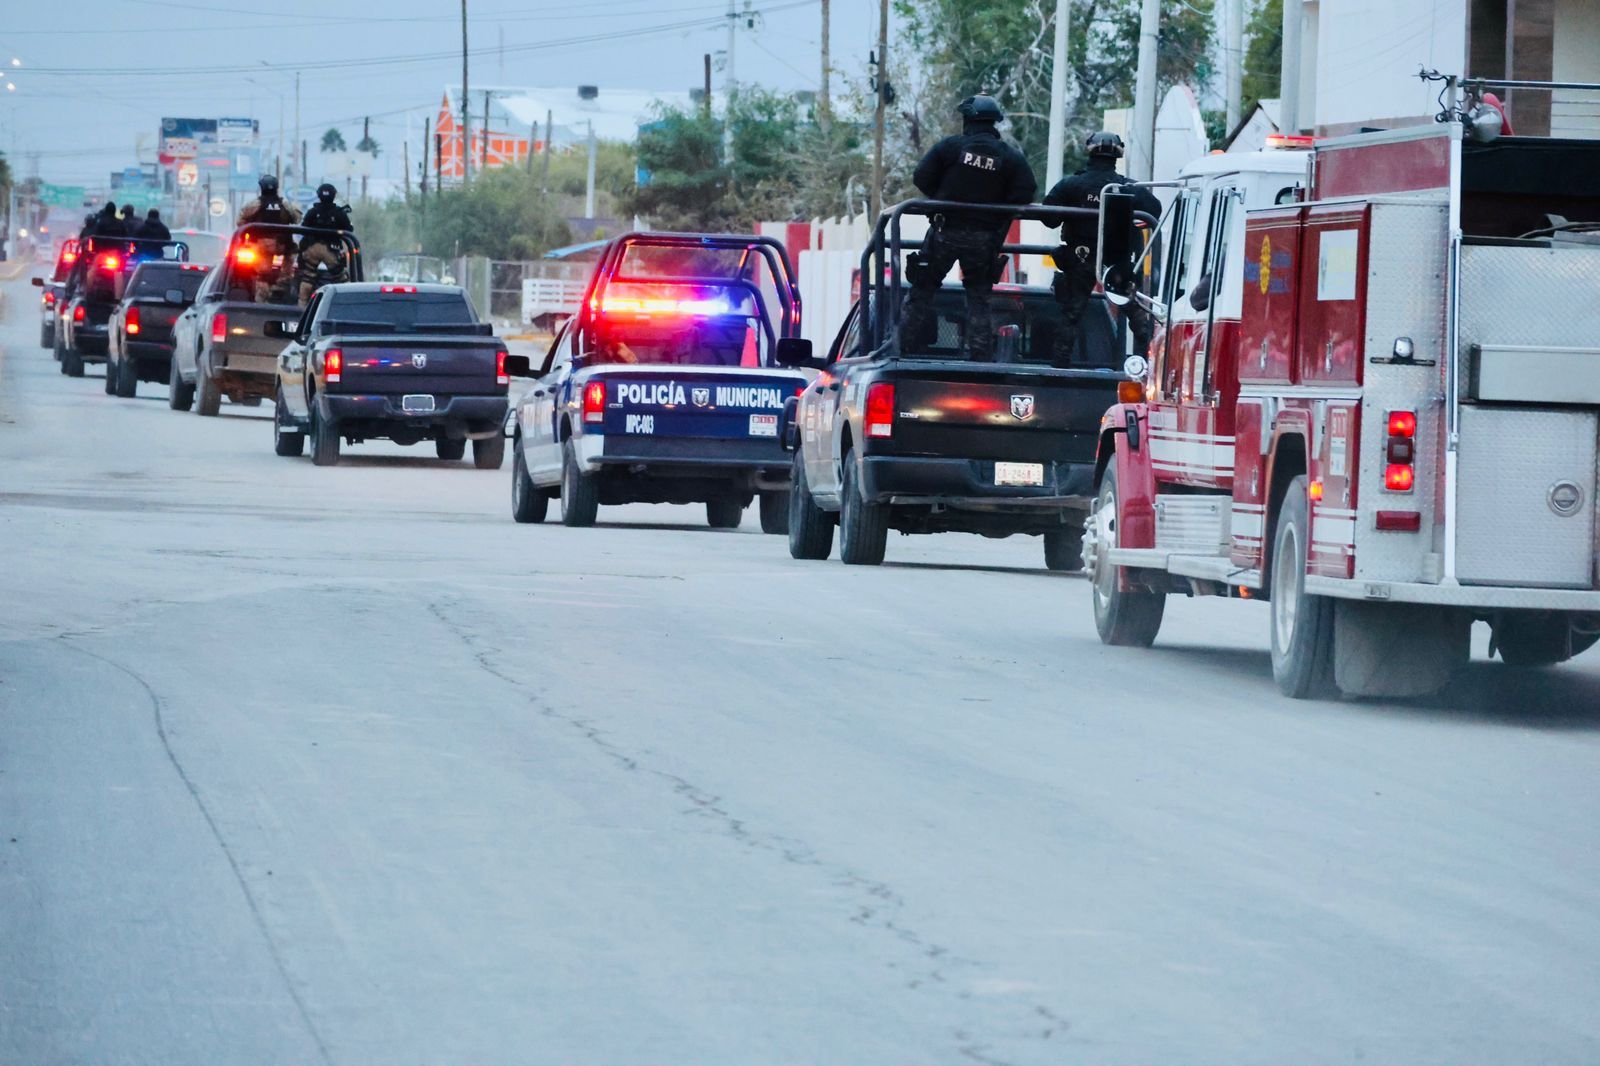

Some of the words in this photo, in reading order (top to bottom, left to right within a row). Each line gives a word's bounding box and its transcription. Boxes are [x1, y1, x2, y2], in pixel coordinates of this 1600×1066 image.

[963, 152, 996, 171] P.A.R.
[617, 380, 687, 406] POLICÍA
[716, 386, 785, 409] MUNICIPAL
